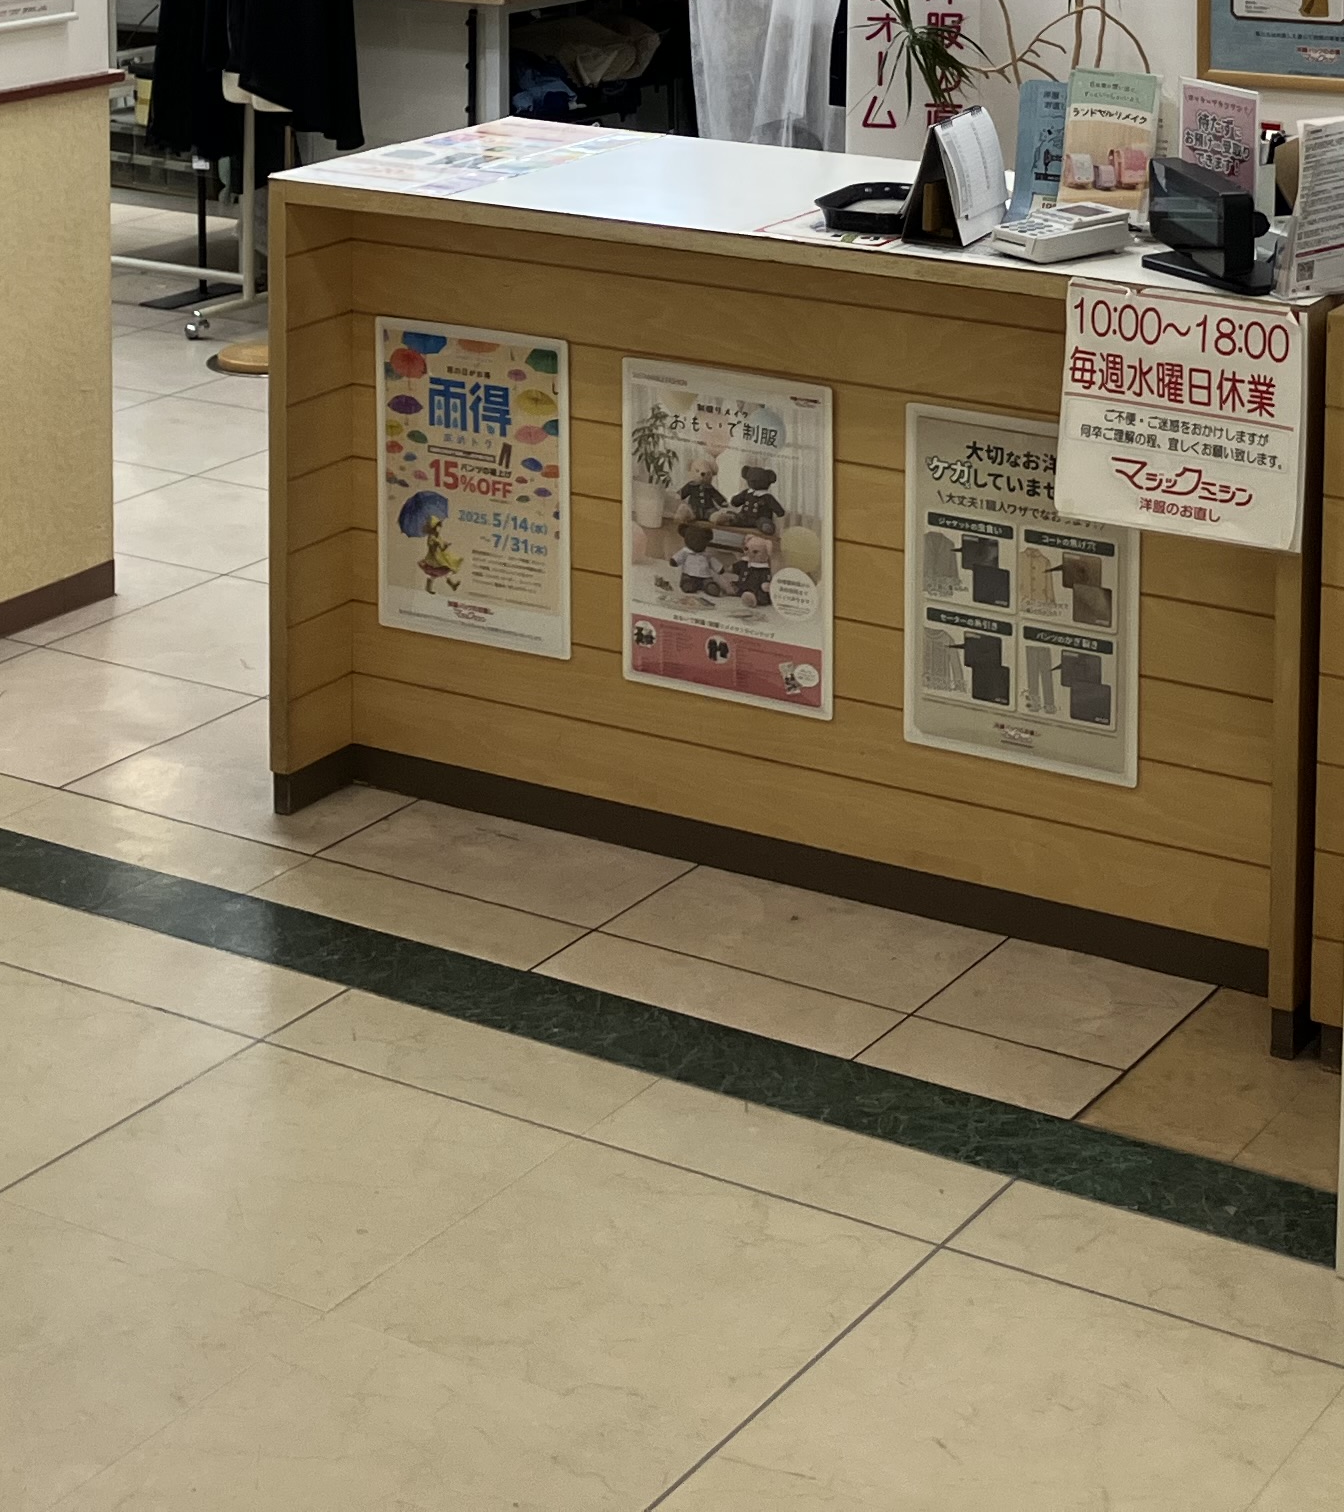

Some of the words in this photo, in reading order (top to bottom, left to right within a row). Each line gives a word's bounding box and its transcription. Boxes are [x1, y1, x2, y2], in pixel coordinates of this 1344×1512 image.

[1071, 106, 1149, 125] ランドセルリメイク
[1197, 110, 1243, 140] 待たずに
[1069, 345, 1276, 419] 毎週水曜日休業
[428, 376, 512, 438] 雨得
[669, 413, 778, 449] おもいで制服
[1103, 408, 1270, 447] ご不便・ご迷惑をおかけしますが
[428, 458, 513, 500] 15%OFF
[1111, 456, 1254, 507] マジックミシン
[1139, 496, 1221, 524] 洋服のお直し
